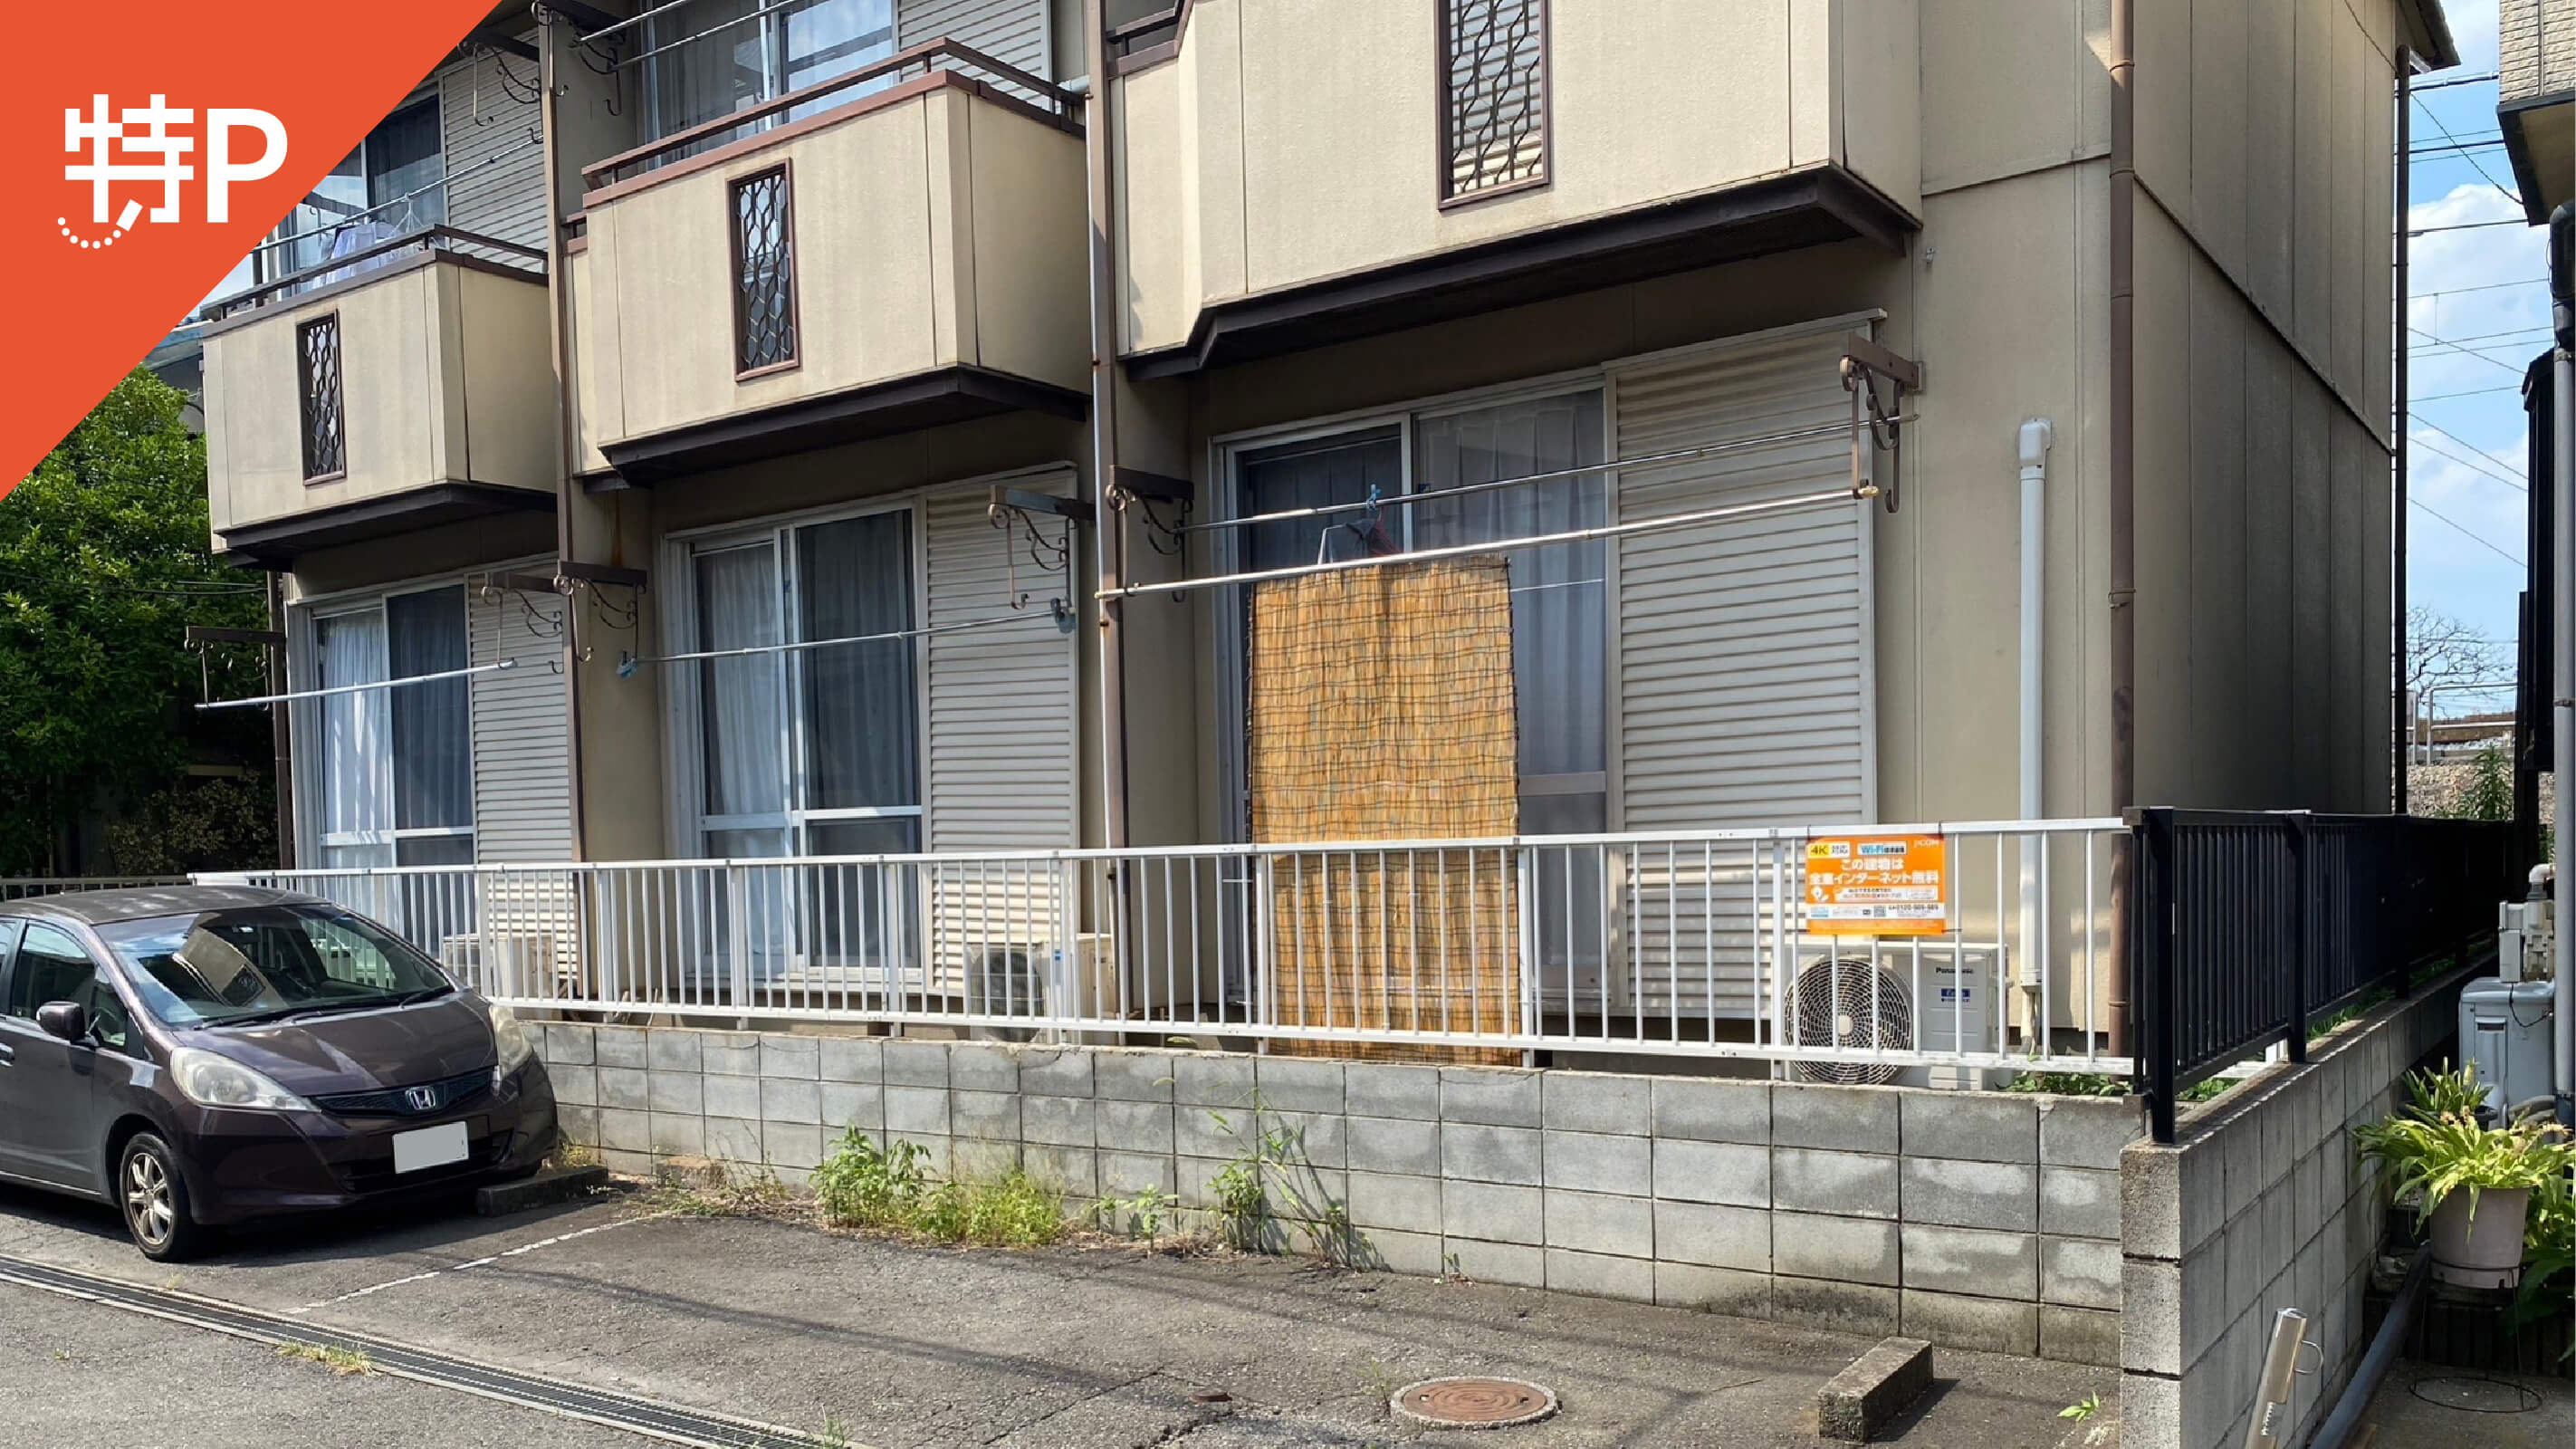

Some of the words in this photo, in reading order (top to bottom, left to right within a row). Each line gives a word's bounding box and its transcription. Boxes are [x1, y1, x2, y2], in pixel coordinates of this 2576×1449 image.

[1810, 845, 1828, 855] 4K
[1840, 859, 1904, 870] この建物は
